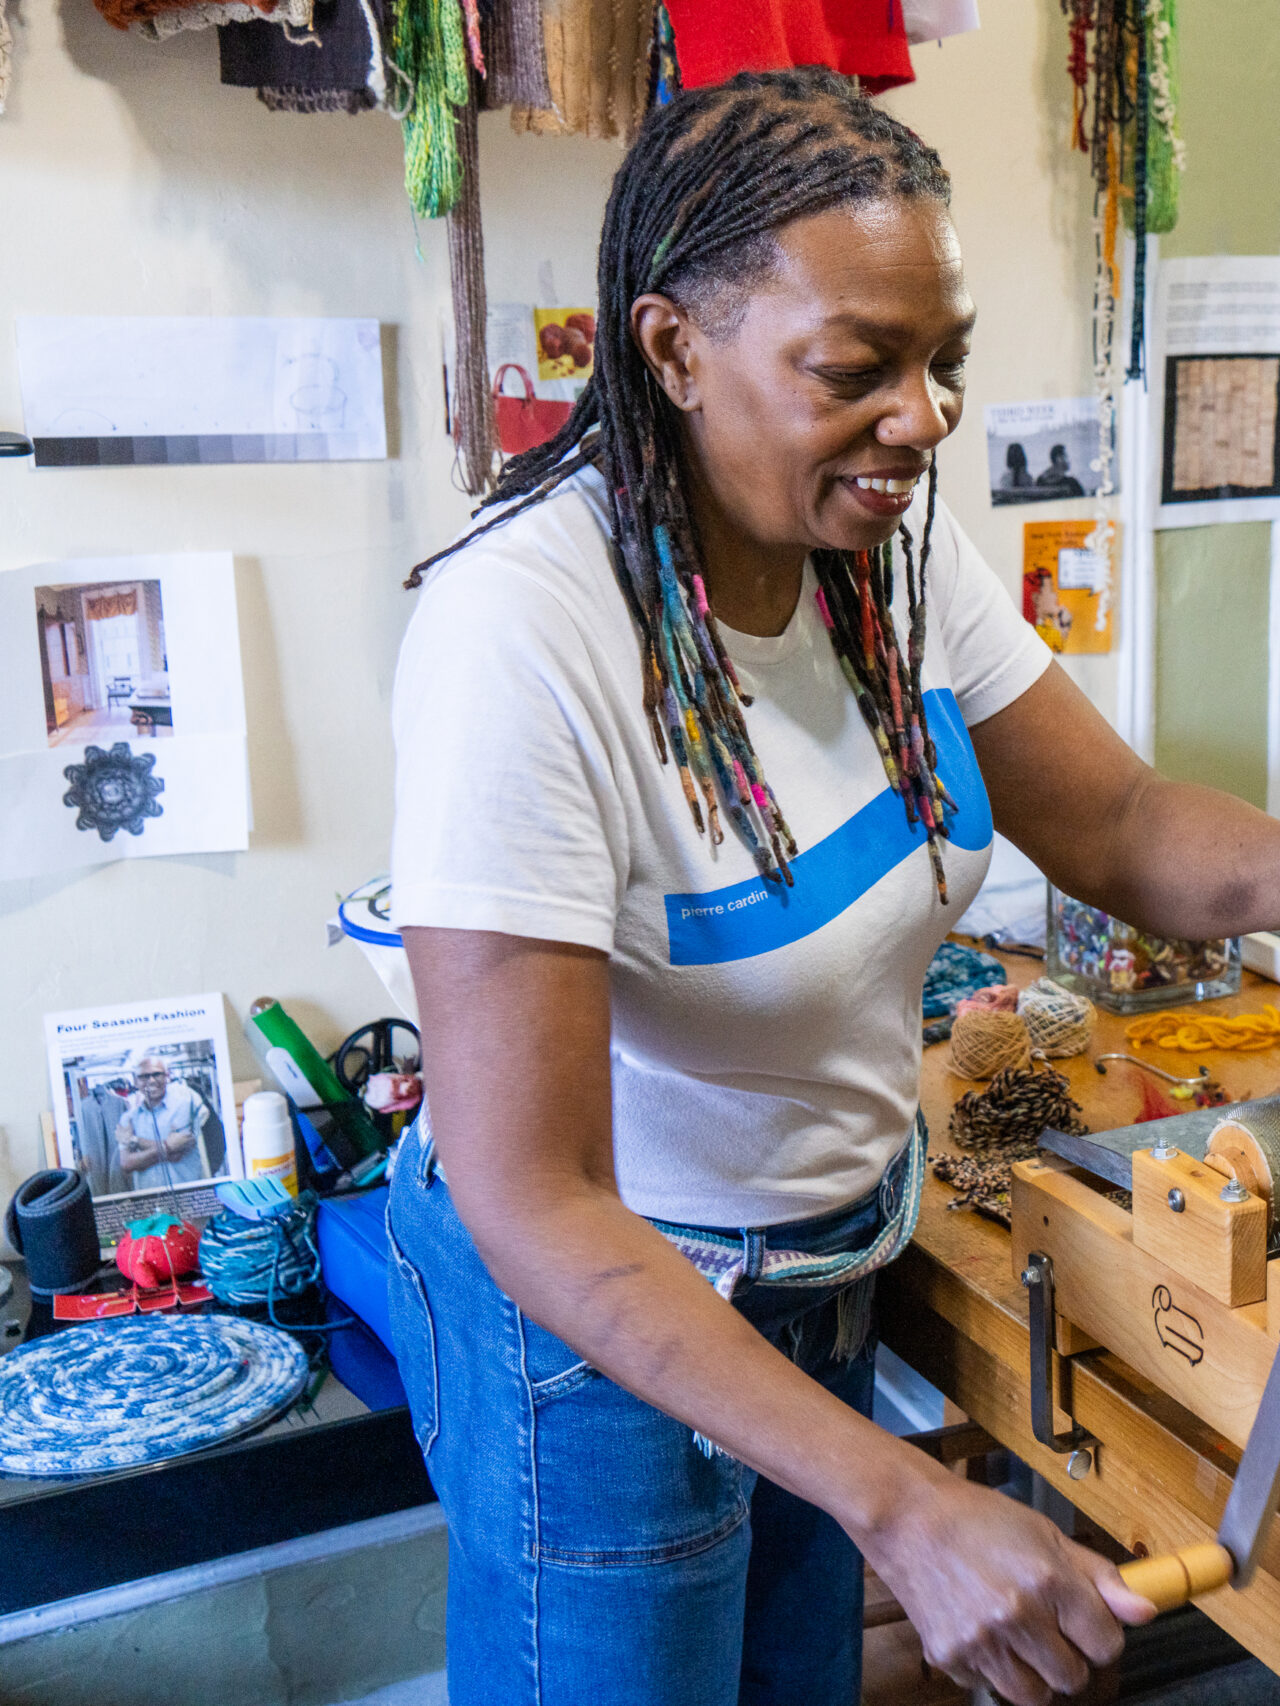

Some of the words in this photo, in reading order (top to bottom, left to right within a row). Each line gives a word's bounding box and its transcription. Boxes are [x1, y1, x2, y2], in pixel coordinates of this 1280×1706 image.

[681, 905, 724, 920] pierre
[727, 890, 769, 911] cardin
[56, 1023, 87, 1033] Four
[92, 1015, 150, 1029] Seasons
[153, 1008, 206, 1020] Fashion
